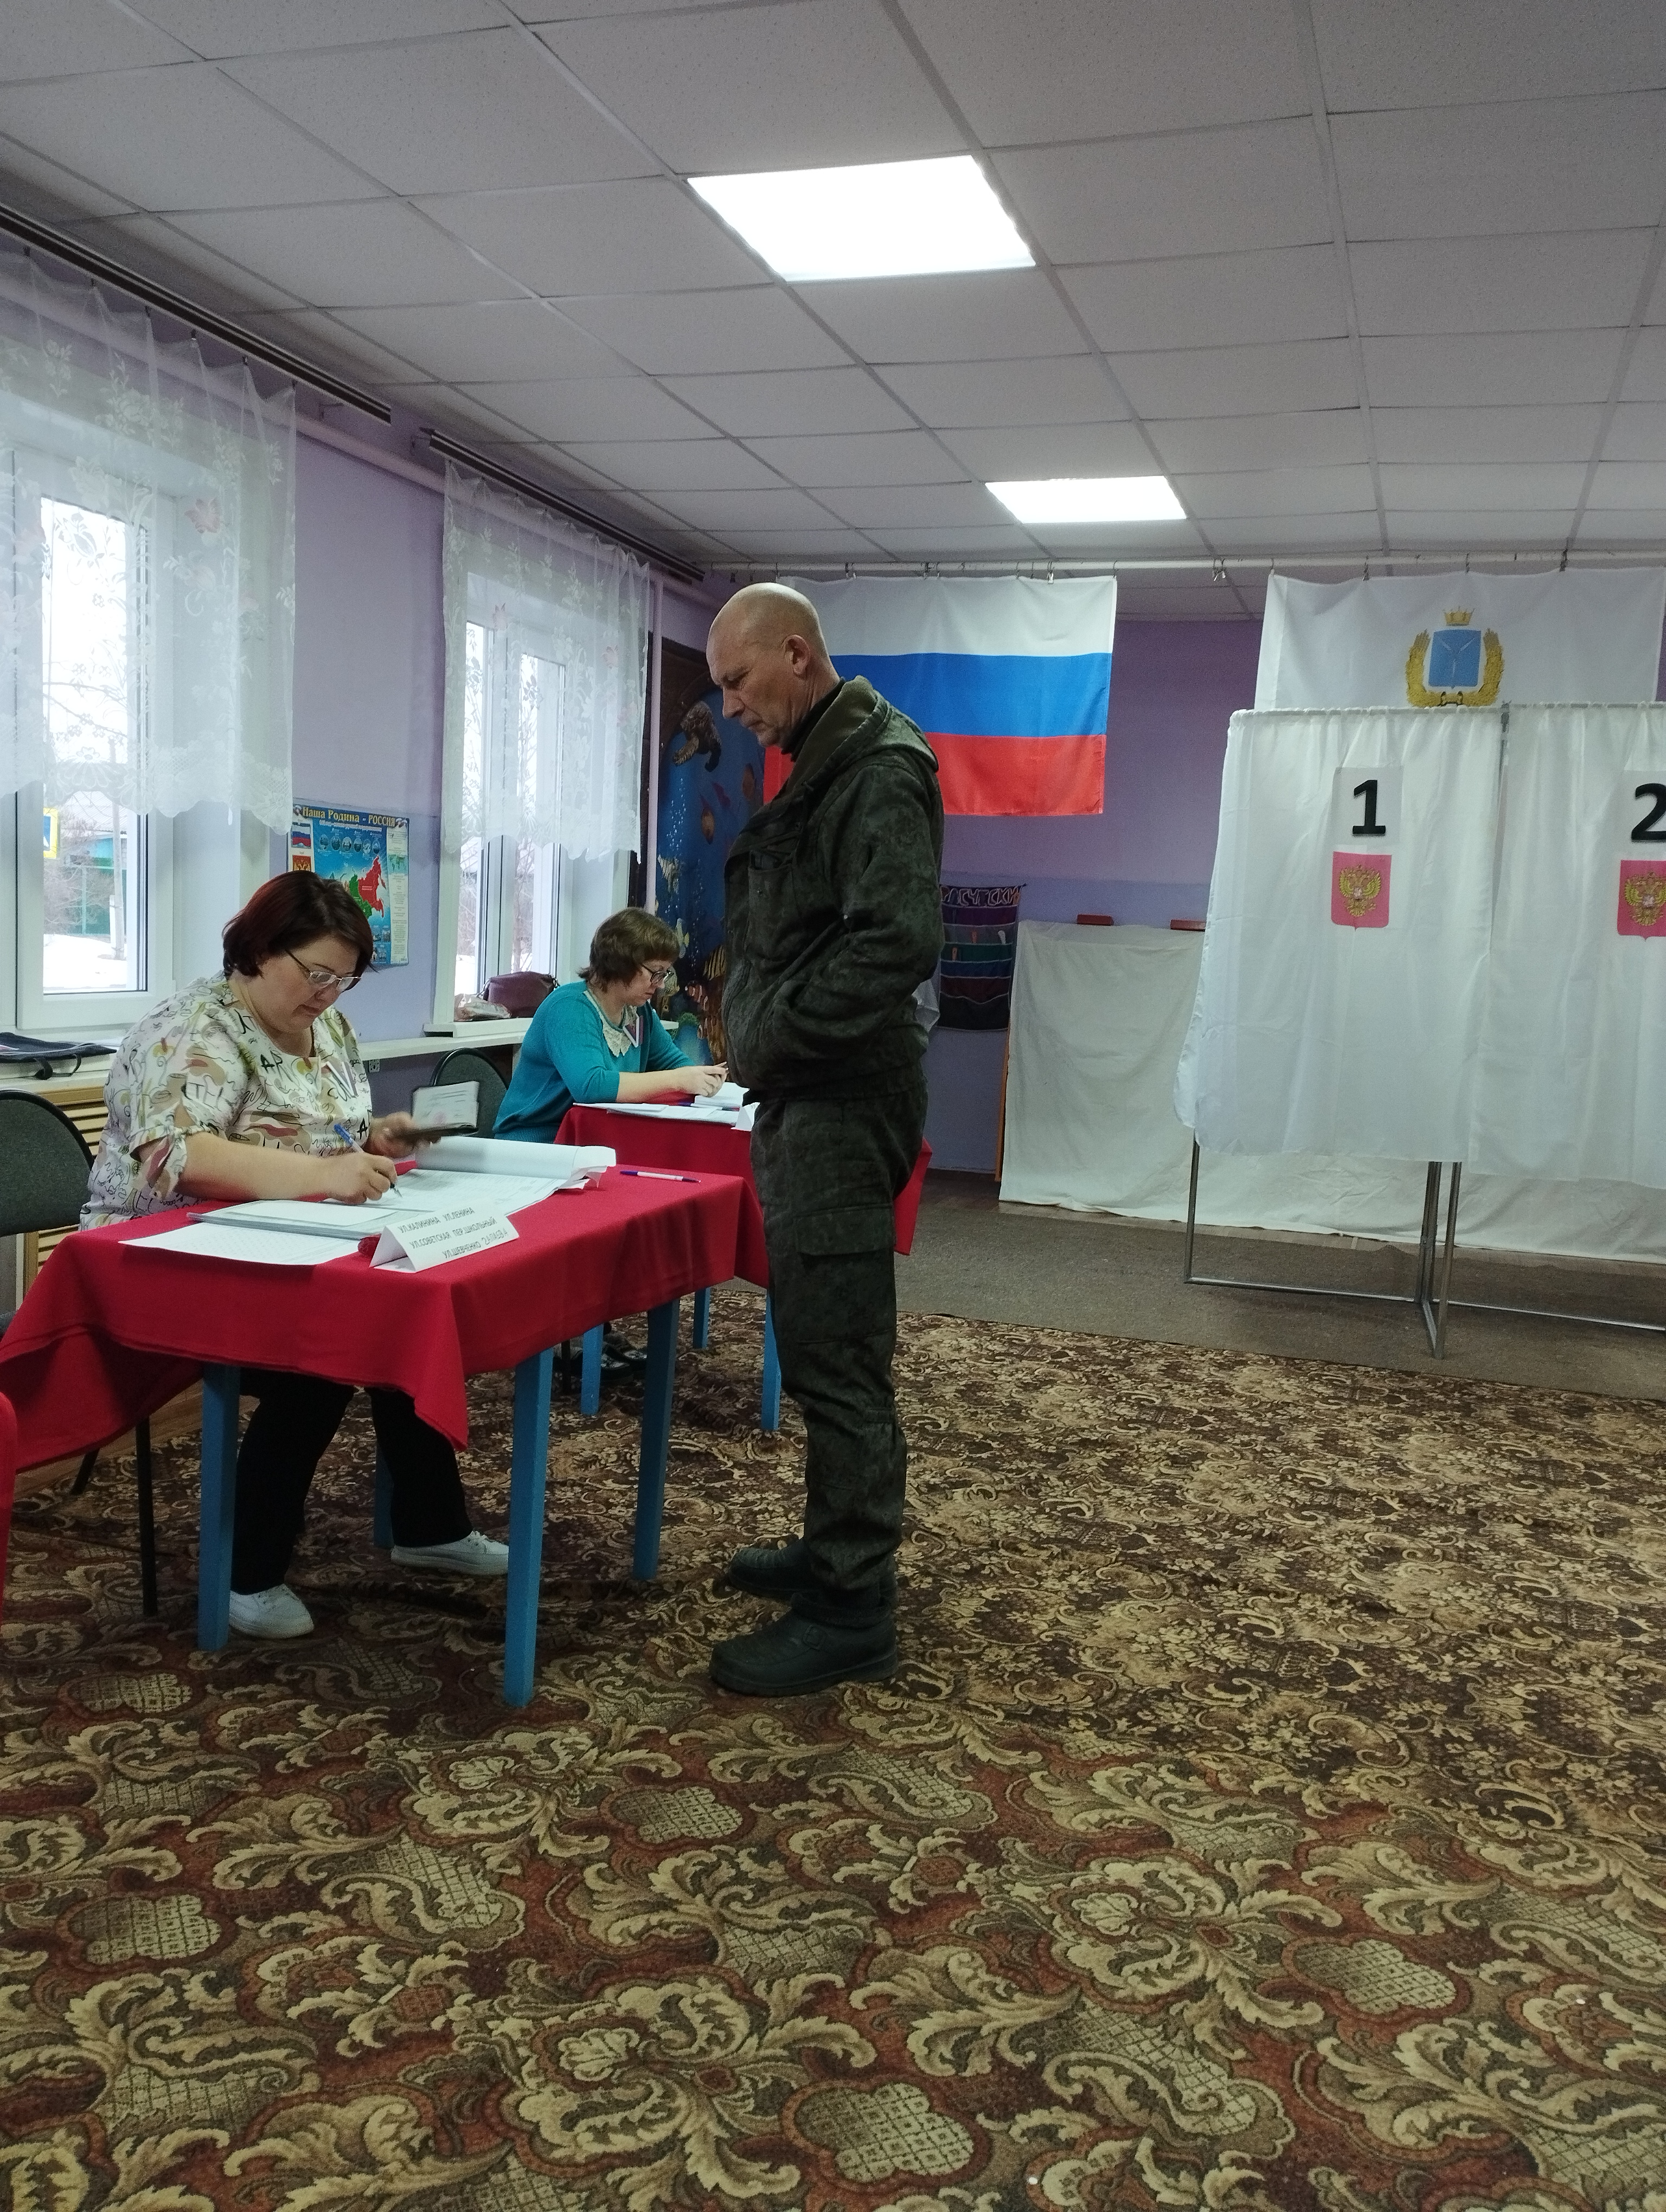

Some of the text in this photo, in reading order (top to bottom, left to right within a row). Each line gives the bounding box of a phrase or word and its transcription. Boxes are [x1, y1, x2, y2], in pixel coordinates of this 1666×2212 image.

[302, 807, 326, 819] Наша
[328, 809, 360, 823] Родина
[368, 814, 396, 827] РОССИЯ
[1352, 779, 1386, 835] 1
[1631, 783, 1666, 841] 2
